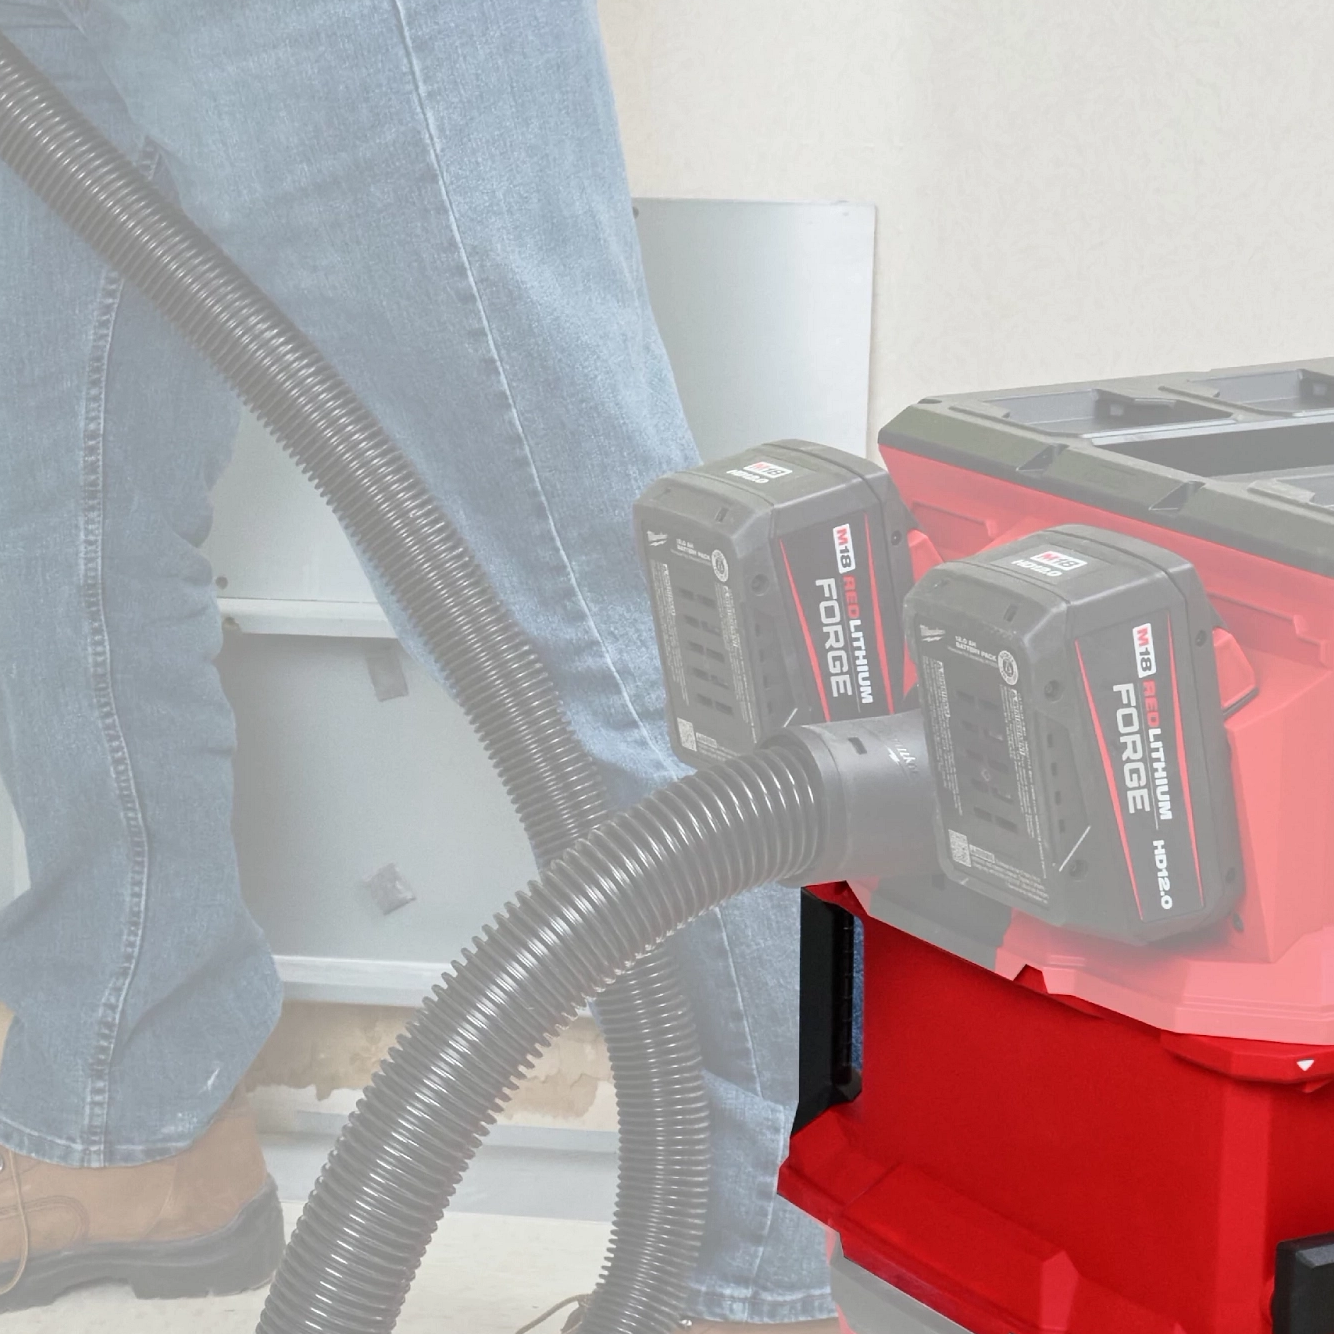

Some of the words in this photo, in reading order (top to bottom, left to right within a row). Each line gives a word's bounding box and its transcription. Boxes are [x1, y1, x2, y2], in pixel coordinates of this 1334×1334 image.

[836, 527, 854, 569] M18
[815, 577, 853, 697] FORGE
[842, 575, 874, 704] REDLITHIUM
[1136, 627, 1153, 673] M18
[1113, 683, 1151, 814] FORGE
[1143, 679, 1173, 820] REDLITHIUM
[1153, 839, 1173, 910] HD12.0
